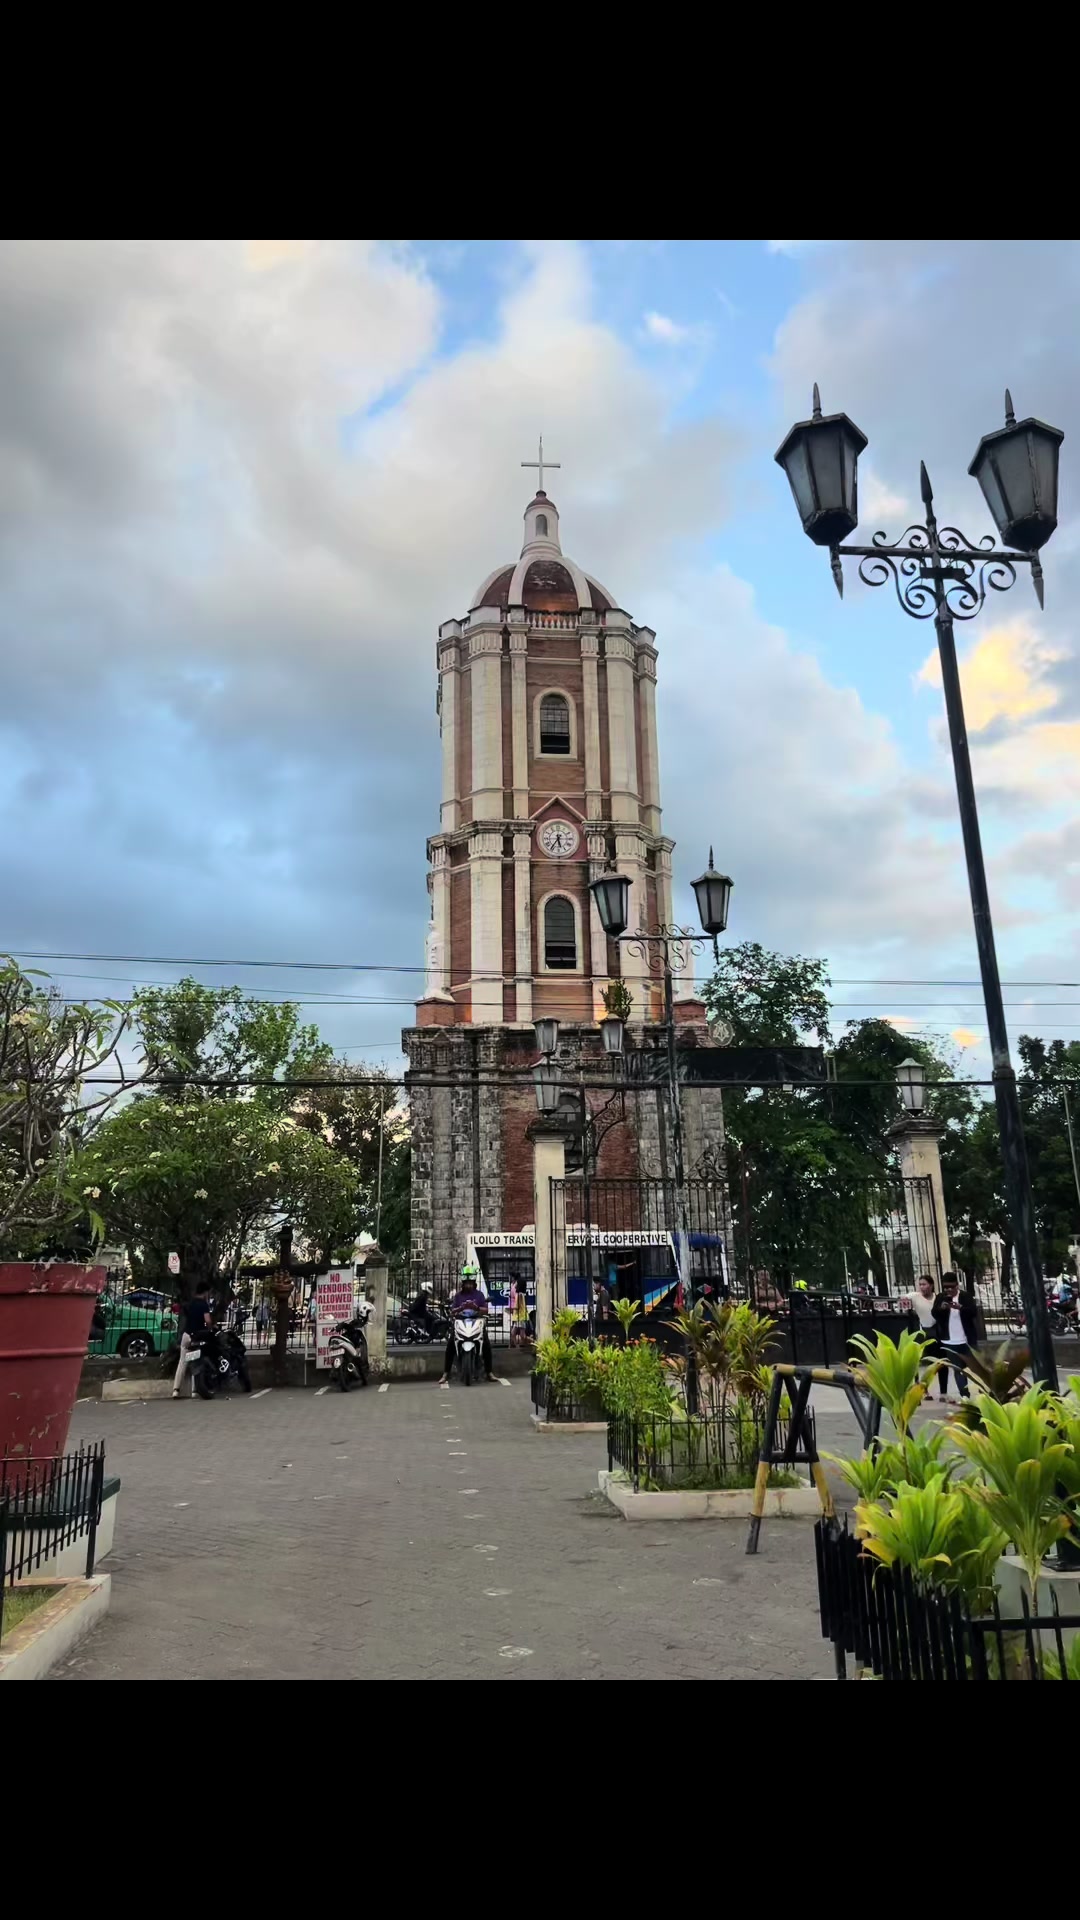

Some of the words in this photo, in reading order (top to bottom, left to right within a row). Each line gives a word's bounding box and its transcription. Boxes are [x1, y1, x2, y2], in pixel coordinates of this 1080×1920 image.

[470, 1235, 500, 1245] ILOILO
[603, 1234, 667, 1244] COOPERATIVE
[330, 1273, 340, 1283] NO
[317, 1283, 352, 1294] VENDORS
[317, 1293, 352, 1304] ALLOWED
